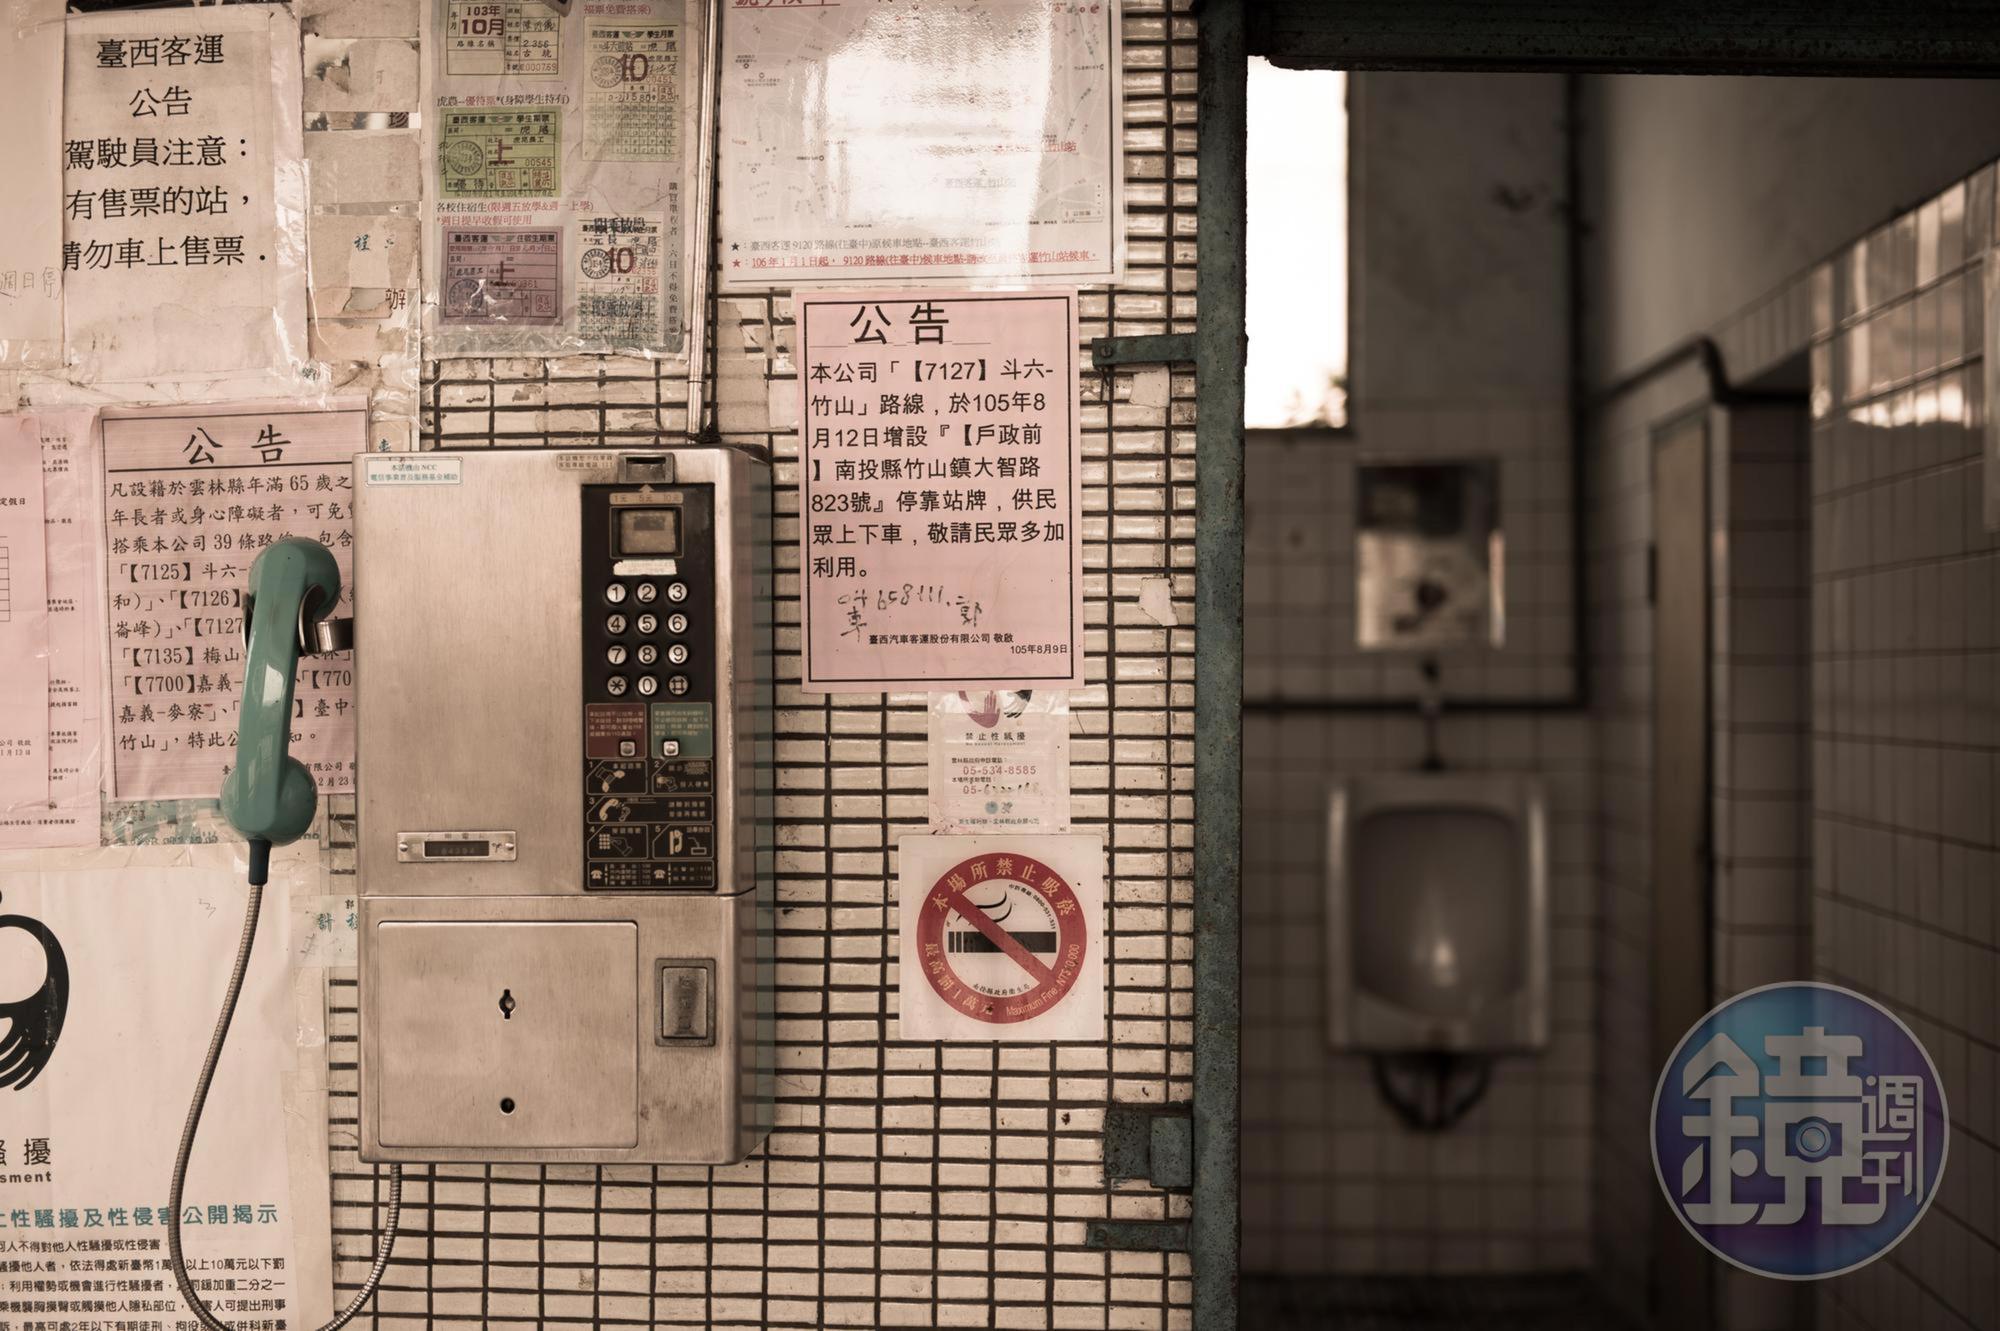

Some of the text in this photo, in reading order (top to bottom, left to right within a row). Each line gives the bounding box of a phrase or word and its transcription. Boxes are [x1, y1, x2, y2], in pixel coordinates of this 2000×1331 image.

[461, 18, 505, 36] 10月
[96, 33, 225, 69] 臺西客運
[129, 86, 192, 118] 公告
[65, 135, 248, 171] 駕駛員注意：
[66, 185, 250, 221] 有售票的站，
[849, 303, 950, 345] 公告
[811, 392, 1047, 417] 竹山」路線，於105年8
[182, 424, 292, 465] 公告
[421, 463, 438, 471] NCC
[813, 456, 1042, 482] 】南投縣竹山鎮大智路
[811, 489, 1058, 513] 823號』停靠站牌，供民
[812, 520, 1065, 546] 眾上下車，敬請民眾多加
[812, 555, 868, 579] 利用。
[612, 585, 682, 600] 1 2 3
[611, 616, 682, 631] 4 5 6
[868, 633, 991, 646] 臺西汽車客運股份有限公司
[1009, 643, 1068, 655] 105年8月9日
[613, 647, 683, 662] 7 8 9
[643, 678, 653, 693] 0
[963, 765, 1037, 776] 05-534-8585
[1006, 997, 1043, 1016] Maximum
